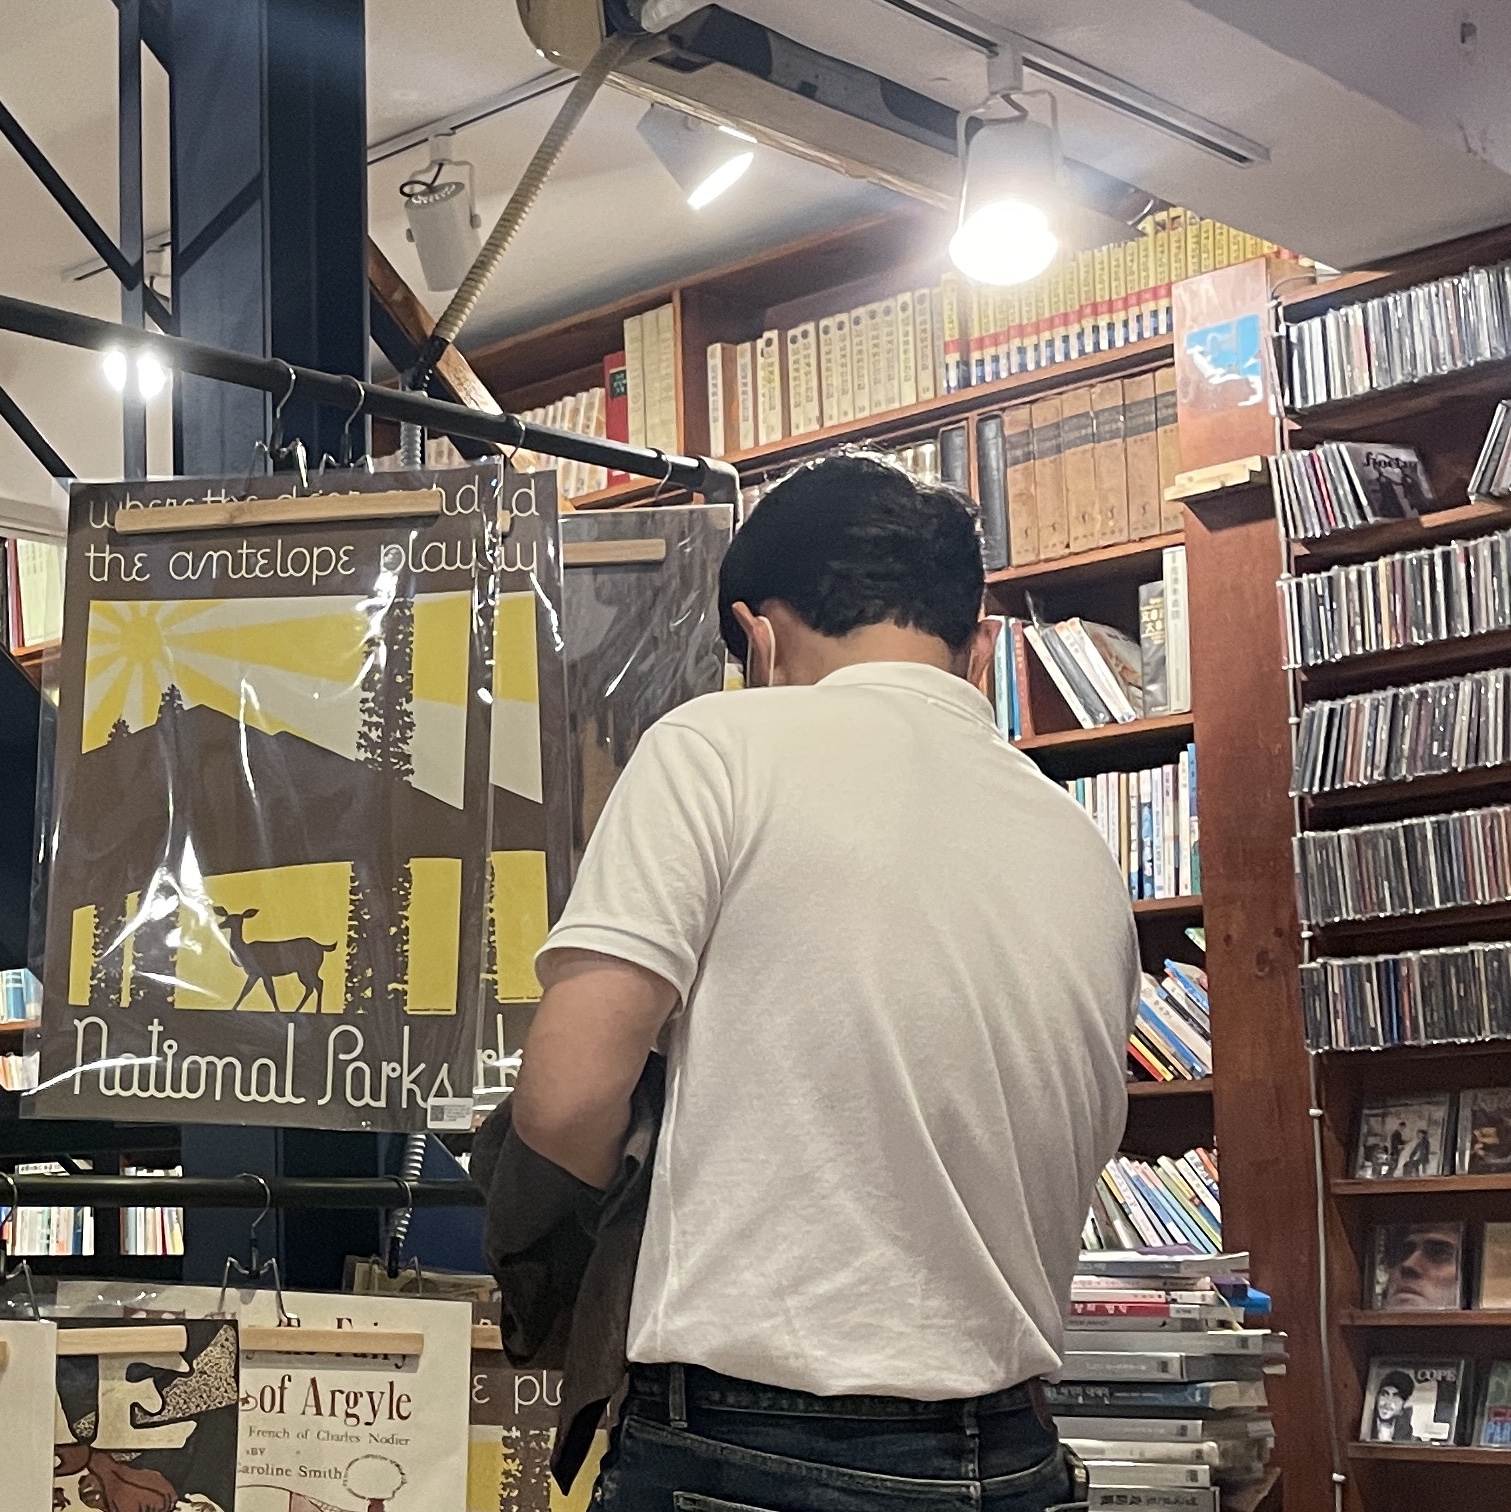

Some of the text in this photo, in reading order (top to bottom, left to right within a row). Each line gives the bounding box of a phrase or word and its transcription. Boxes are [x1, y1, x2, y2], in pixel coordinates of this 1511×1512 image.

[85, 544, 151, 582] the
[169, 539, 355, 586] antelope
[73, 1016, 306, 1104] National
[317, 1024, 453, 1109] Parks
[259, 1373, 412, 1427] of Argyle
[247, 1425, 411, 1446] French of Charles Nodier
[298, 1465, 342, 1480] Smith
